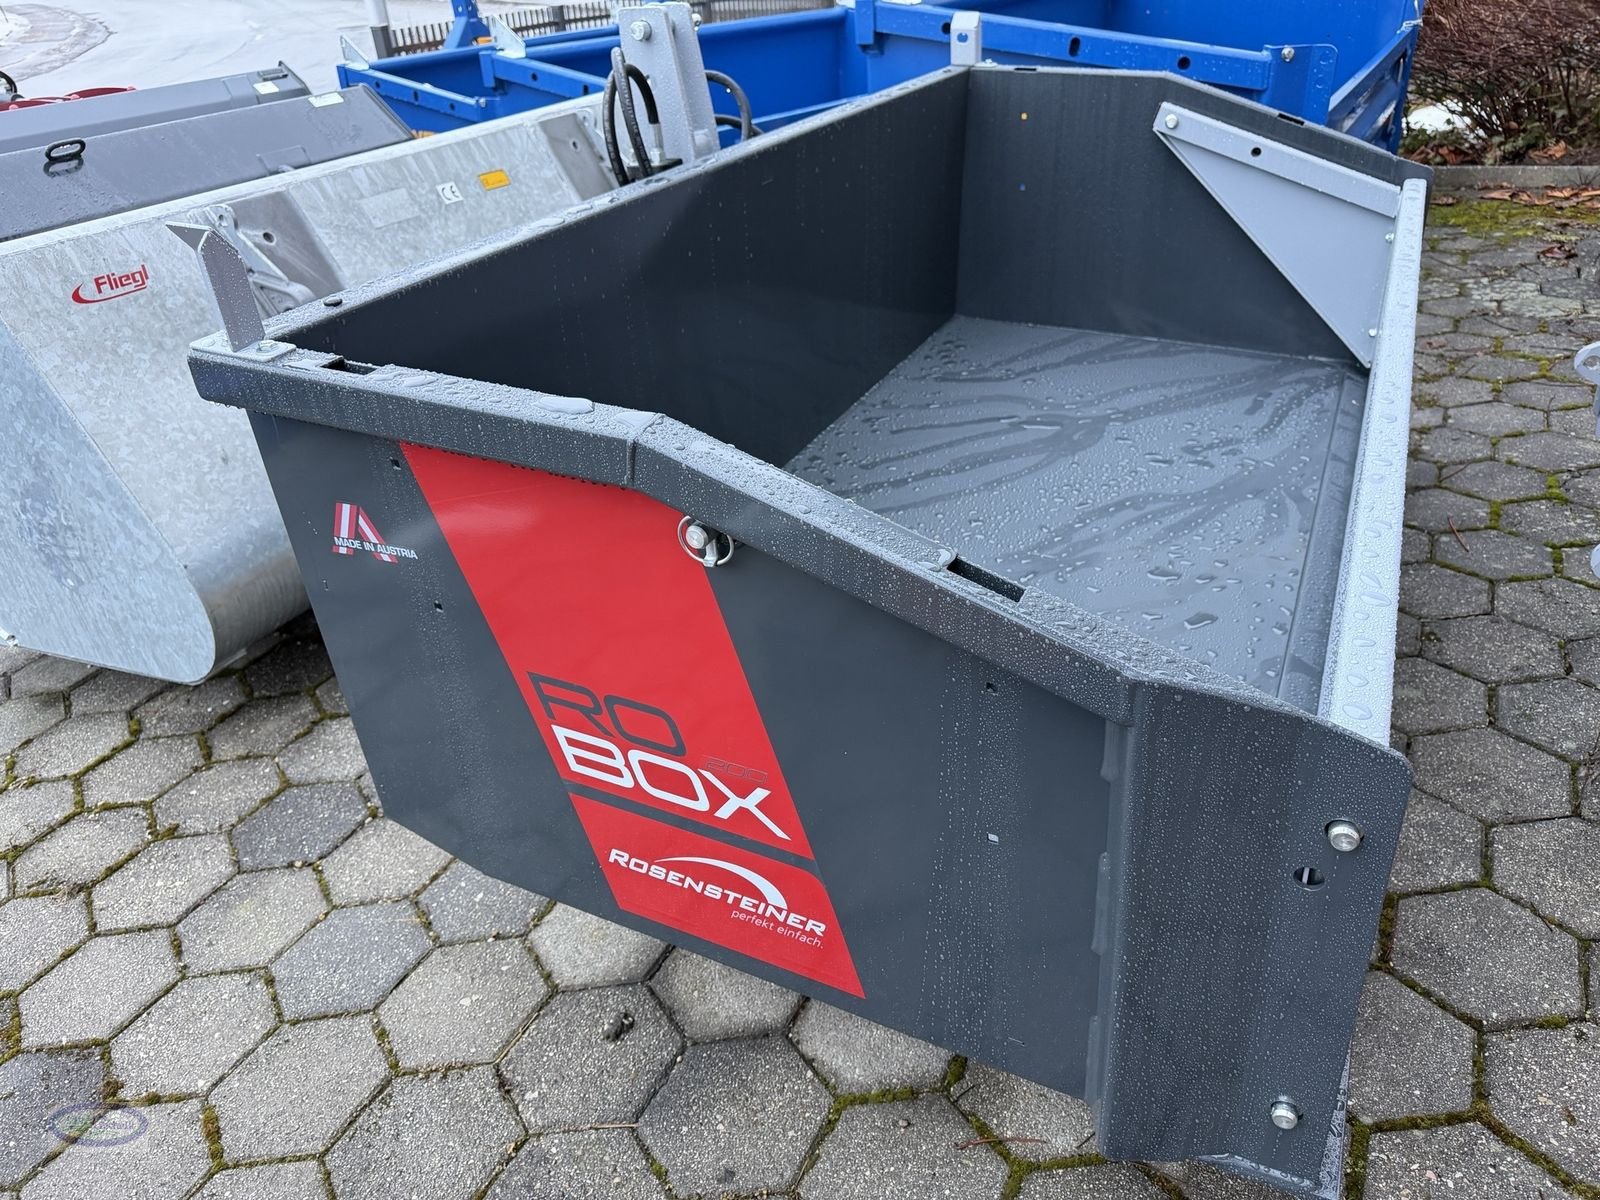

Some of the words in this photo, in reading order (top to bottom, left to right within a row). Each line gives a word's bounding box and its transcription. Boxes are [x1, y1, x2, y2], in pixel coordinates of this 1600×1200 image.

[94, 264, 149, 294] Fliegl
[333, 536, 363, 550] MADE
[363, 542, 375, 552] IN
[377, 544, 419, 560] AUSTRIA
[528, 672, 686, 757] RO
[551, 724, 791, 841] BOX
[608, 848, 827, 937] ROSENSTEINER
[731, 909, 774, 932] perfekt
[776, 926, 825, 950] einfach.
